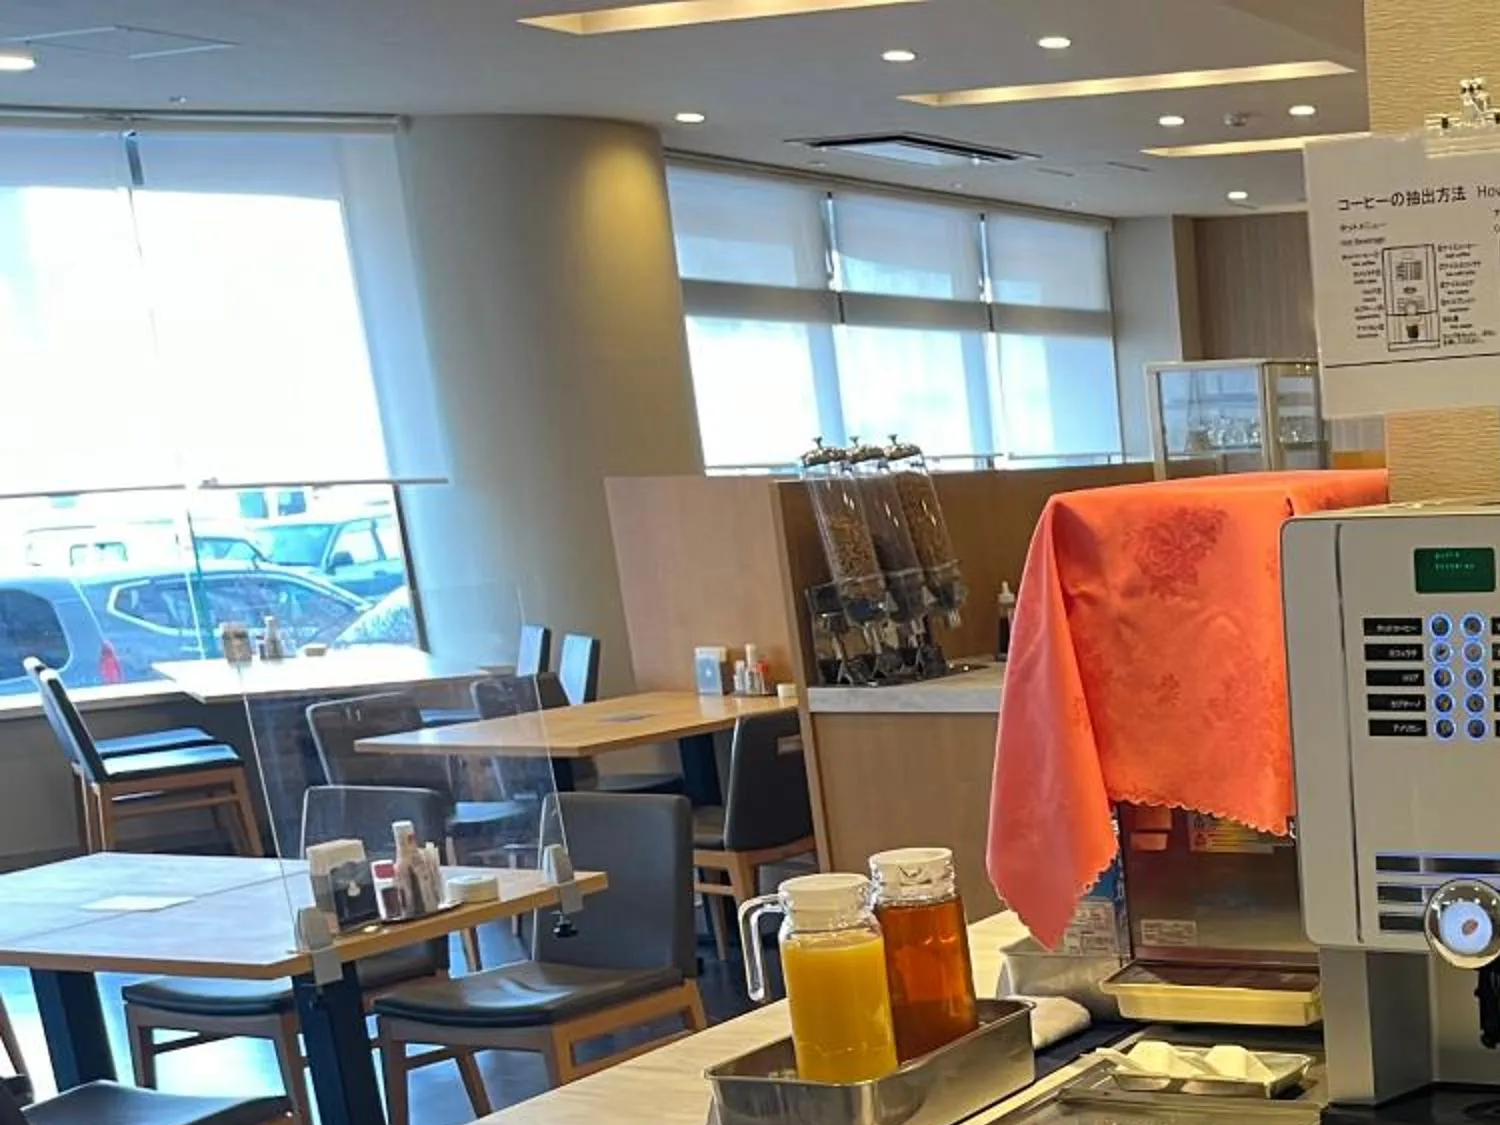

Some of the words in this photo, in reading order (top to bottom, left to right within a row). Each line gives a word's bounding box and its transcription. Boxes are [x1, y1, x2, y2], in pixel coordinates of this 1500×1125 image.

[1337, 185, 1467, 210] コーヒーの抽出方法
